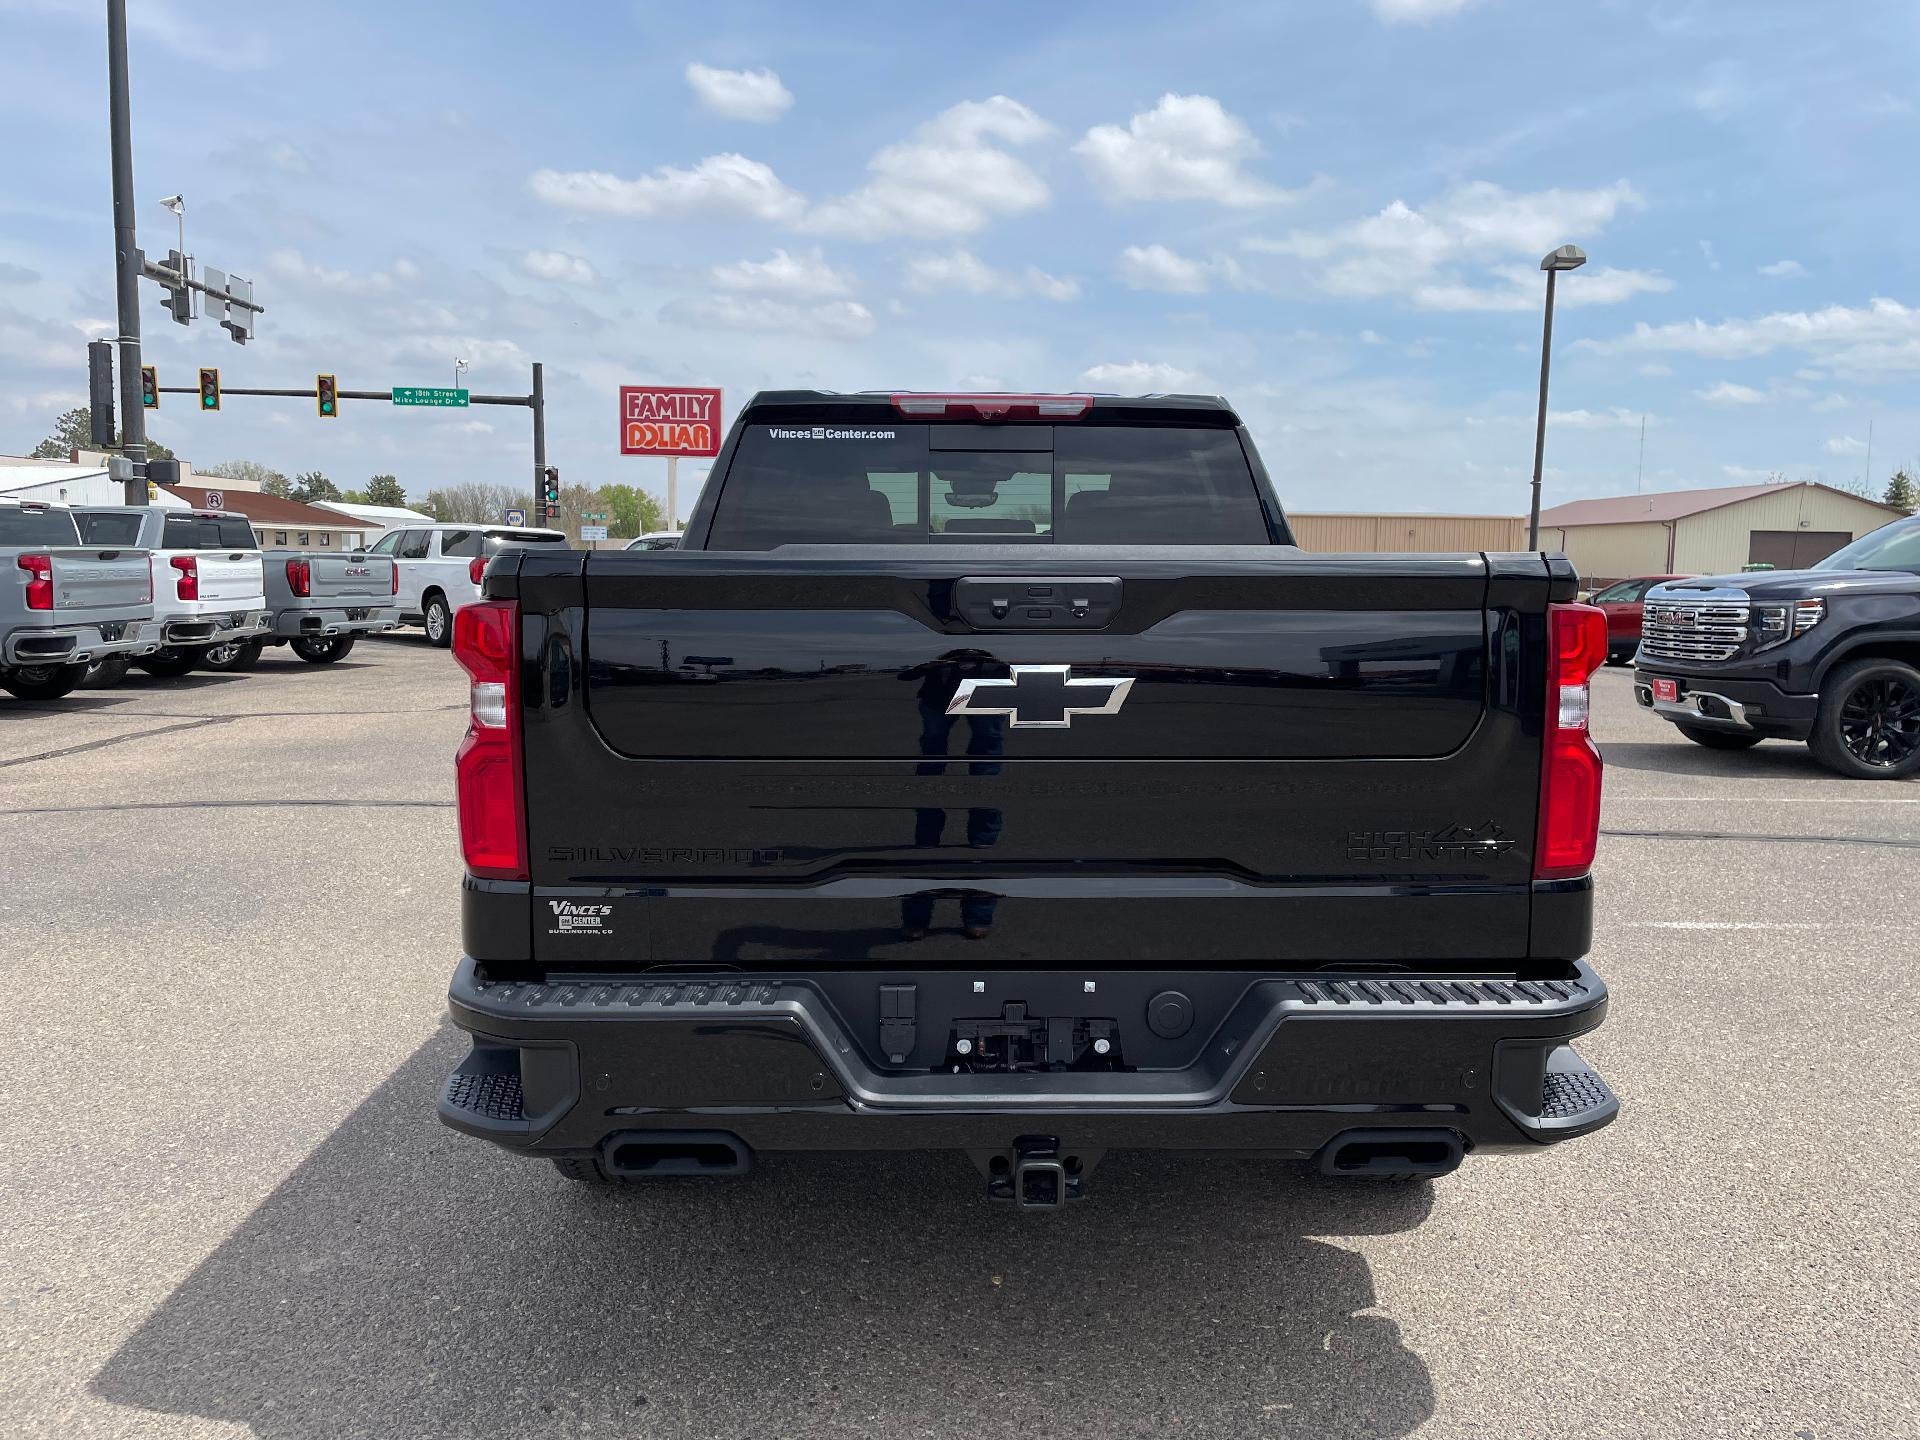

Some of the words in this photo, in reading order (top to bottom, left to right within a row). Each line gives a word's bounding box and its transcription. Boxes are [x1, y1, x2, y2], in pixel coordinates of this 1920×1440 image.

[433, 390, 457, 398] Street
[626, 393, 715, 420] FAMILY
[626, 422, 711, 450] DOLLAR
[1656, 611, 1695, 626] GMC
[548, 847, 784, 864] SILVERADO
[572, 916, 601, 925] CENTER
